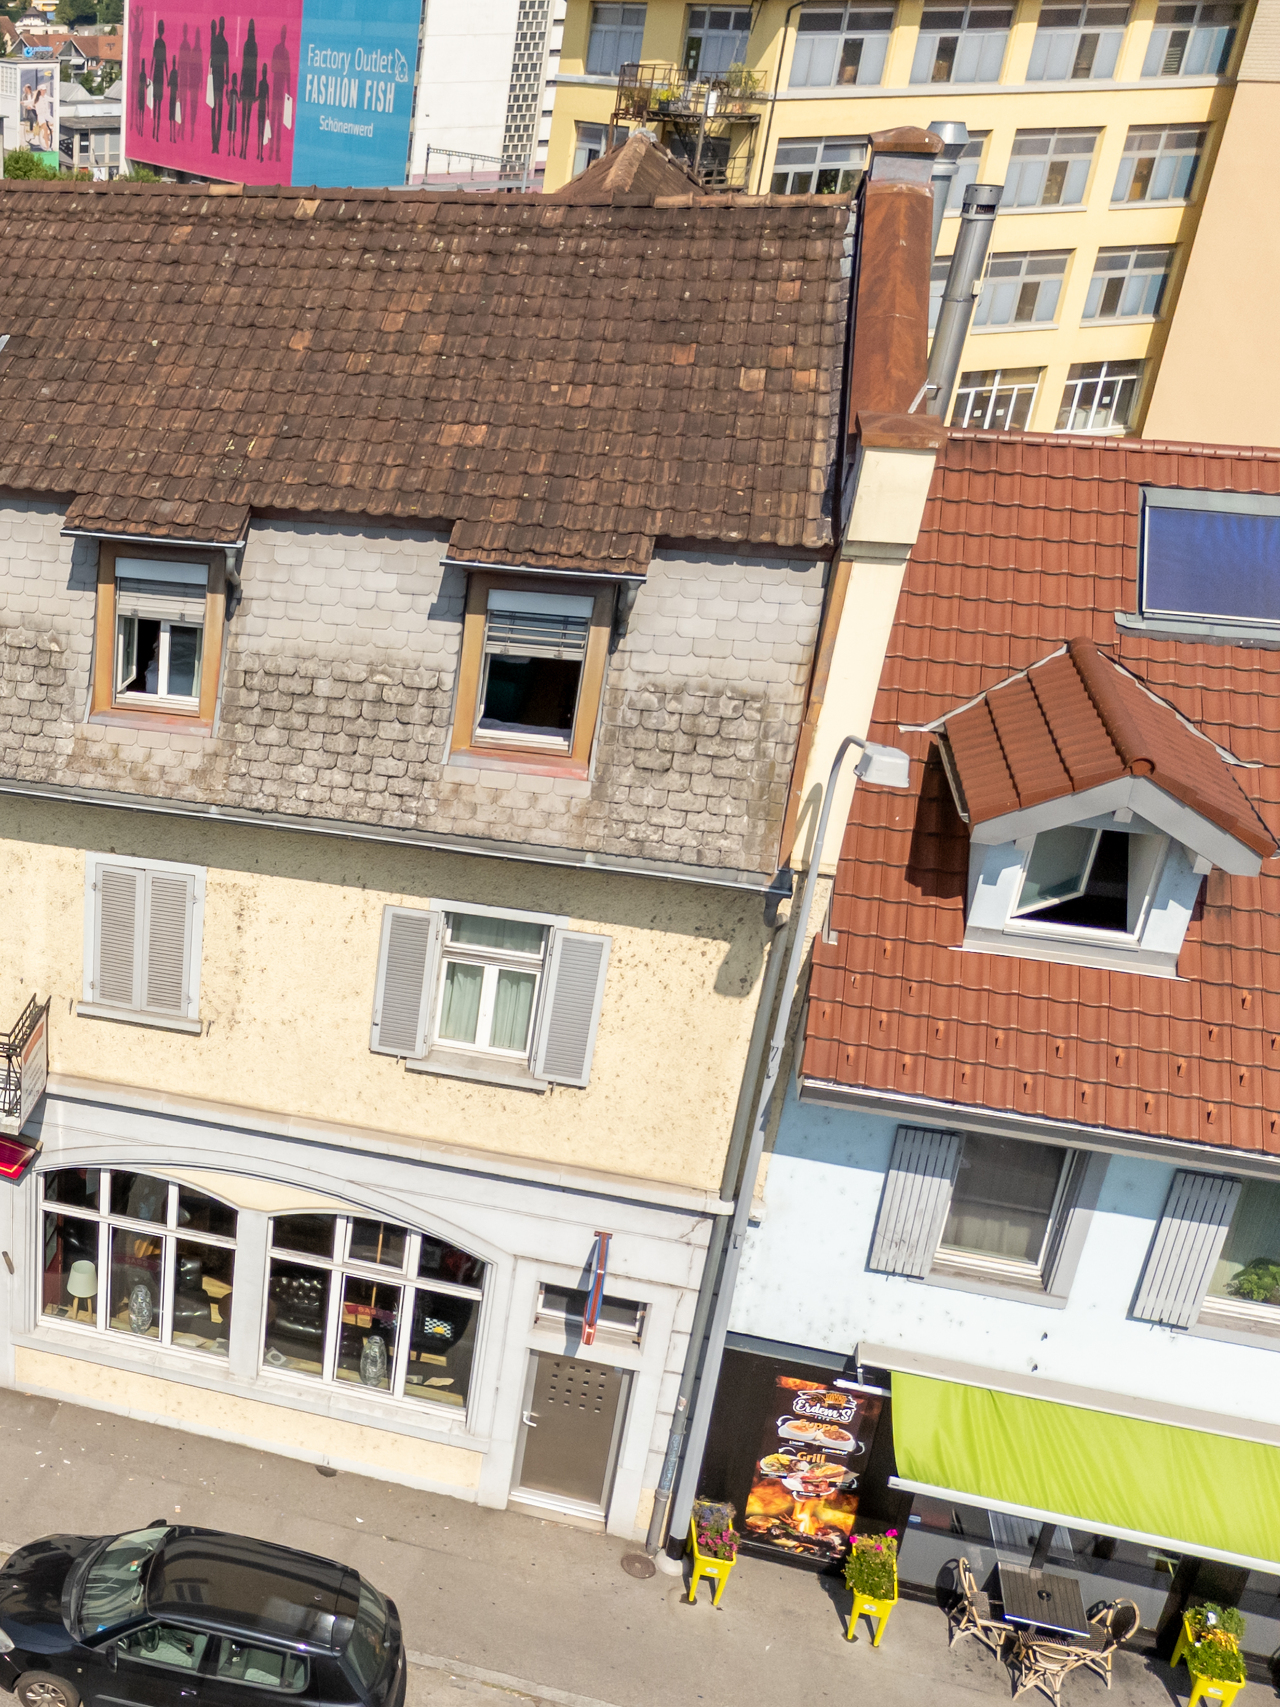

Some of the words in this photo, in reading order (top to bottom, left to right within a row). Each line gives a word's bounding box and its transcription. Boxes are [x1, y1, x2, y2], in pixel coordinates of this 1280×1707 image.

[307, 44, 351, 75] Factory
[355, 47, 393, 73] Outlet
[305, 74, 358, 109] FASHION
[364, 80, 395, 113] FISH
[319, 115, 374, 138] Schönenwerd
[799, 1418, 839, 1433] Suppe
[797, 1451, 826, 1463] Grill
